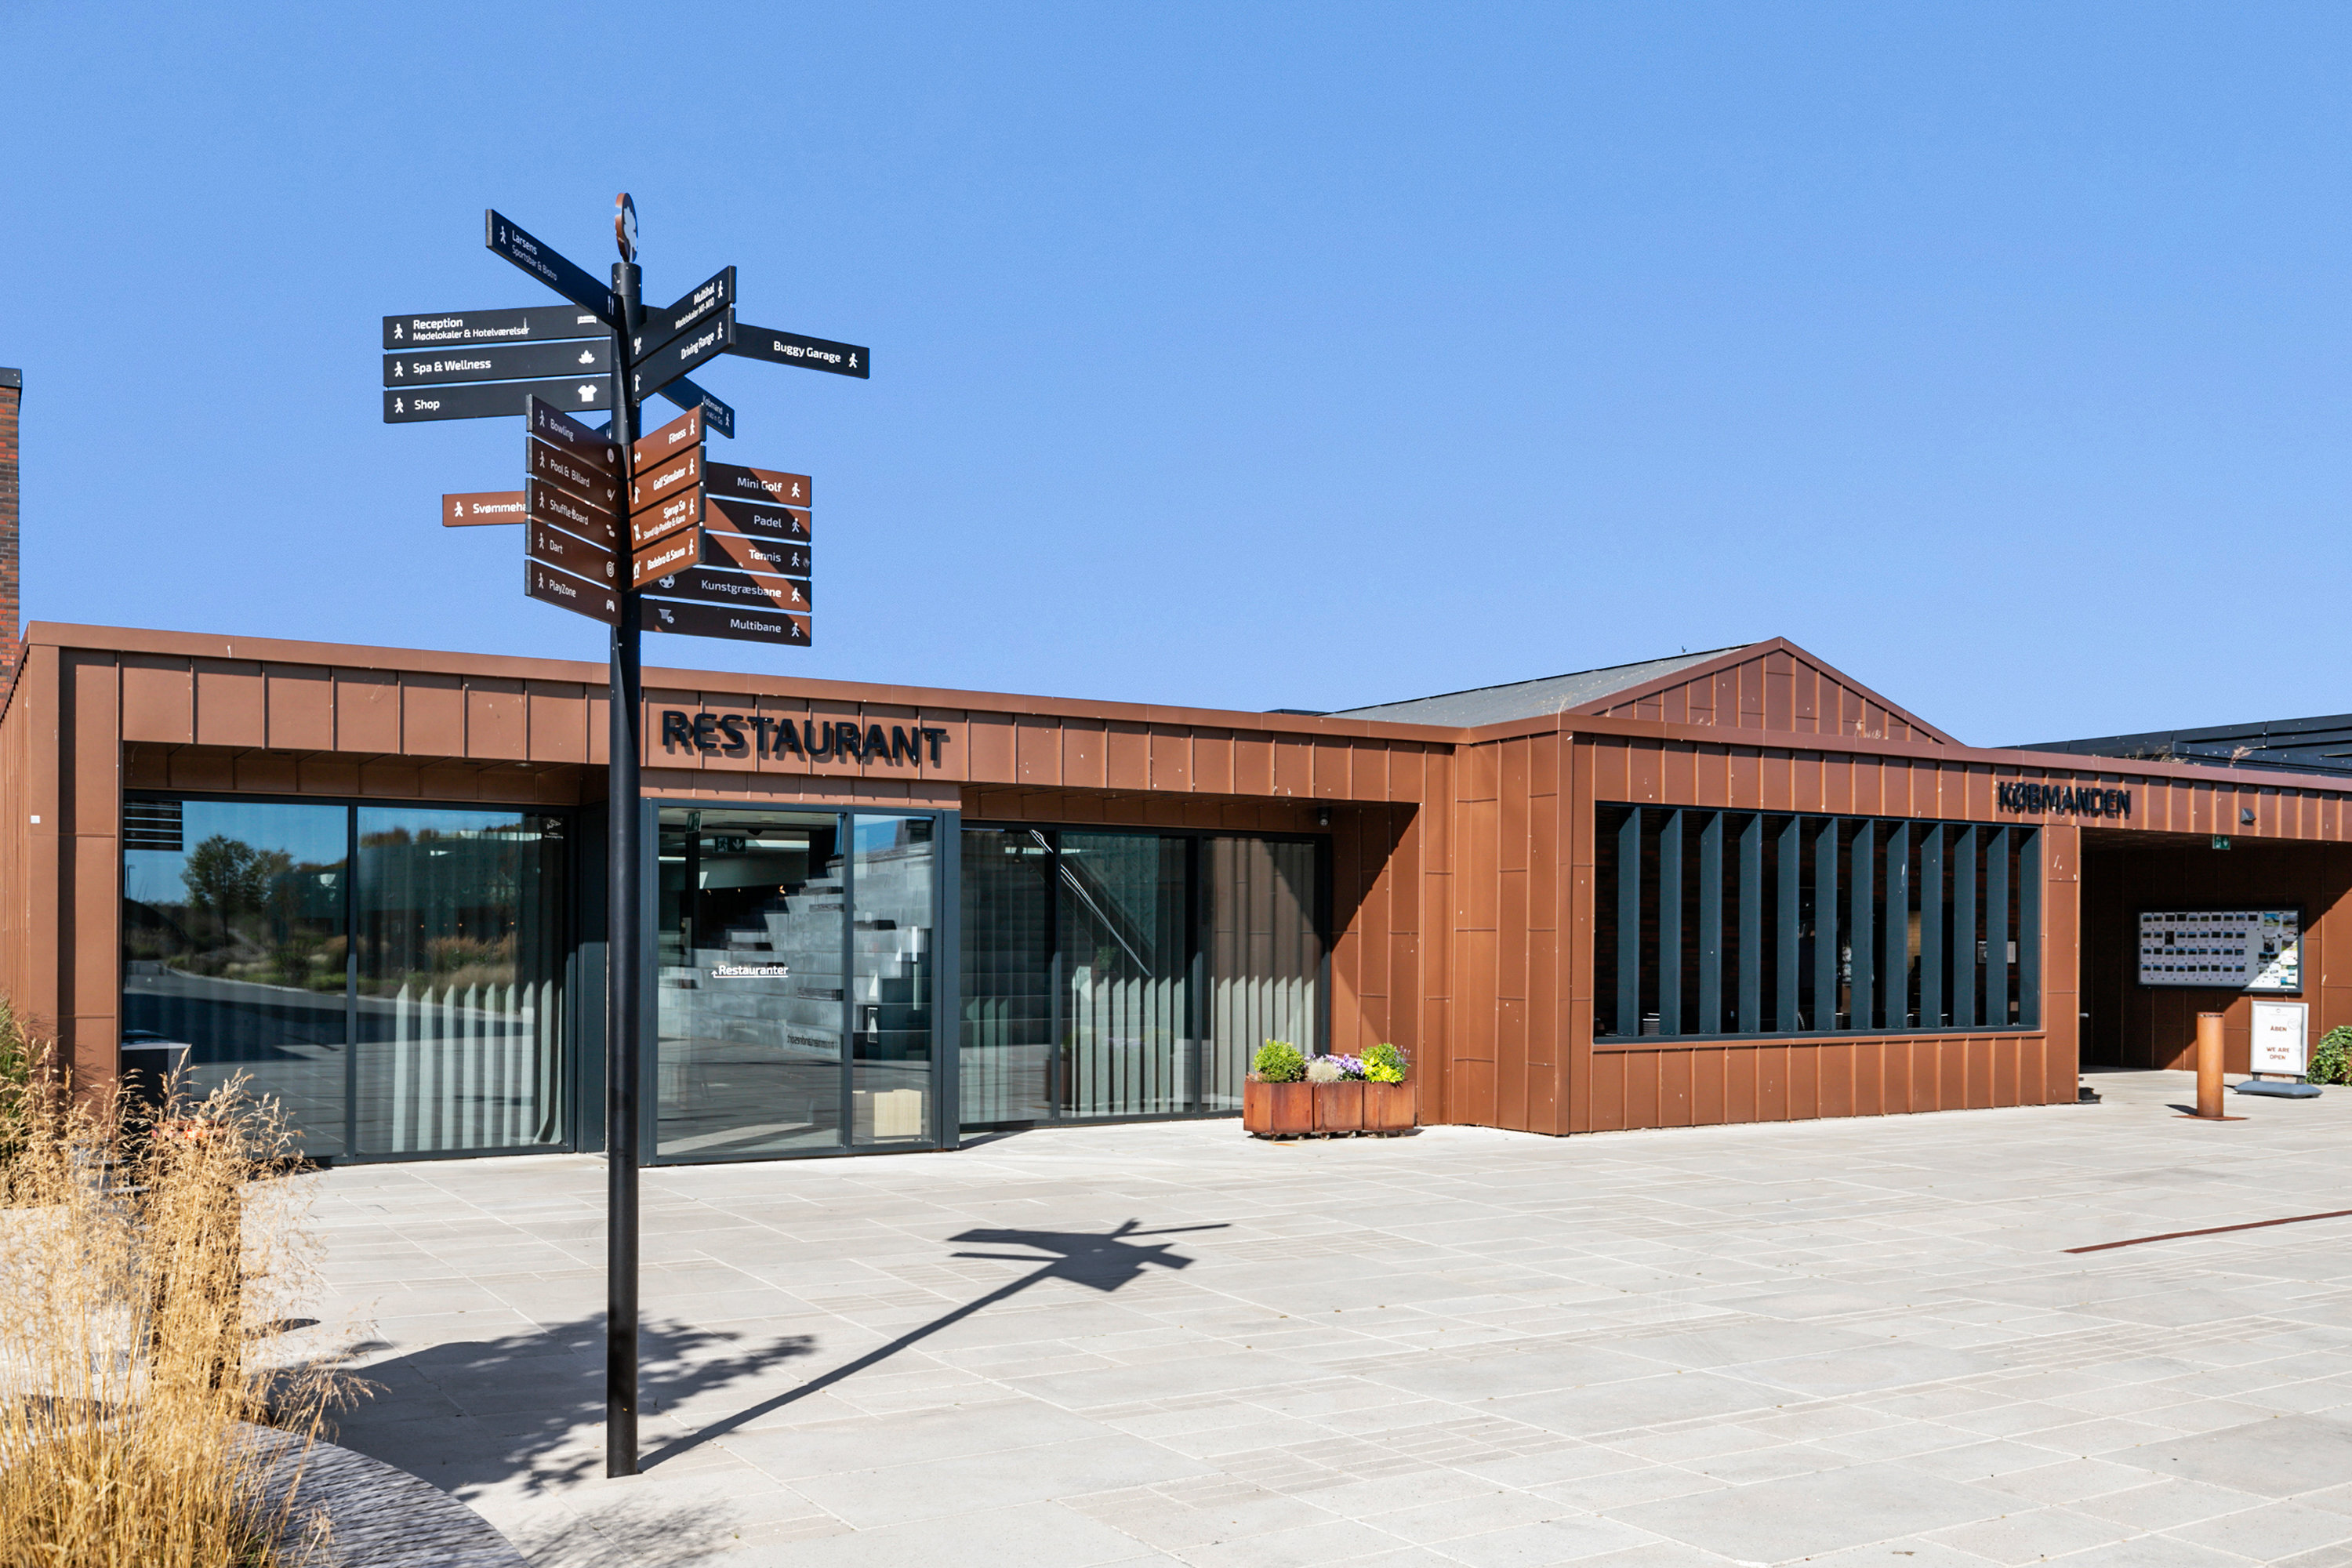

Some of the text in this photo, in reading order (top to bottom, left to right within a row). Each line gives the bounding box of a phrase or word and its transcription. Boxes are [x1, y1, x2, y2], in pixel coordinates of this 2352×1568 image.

[512, 230, 537, 255] Larsens
[537, 261, 543, 271] &
[413, 319, 463, 330] Reception
[413, 332, 463, 341] Mødelokaler
[472, 326, 530, 338] Hotelværelser
[681, 332, 714, 360] Driving Range
[773, 341, 841, 364] Buggy Garage
[413, 360, 492, 375] Spa & Wellness
[415, 400, 440, 411] Shop
[550, 419, 574, 442] Bowling
[669, 428, 686, 445] Fitness
[550, 459, 590, 487] Pool & Billard
[653, 467, 686, 491] Golf Simulator
[737, 477, 782, 492] Mini Golf
[753, 515, 782, 528] Padel
[550, 539, 563, 554] Dart
[670, 547, 686, 561] Sauna
[749, 549, 782, 562] Tennis
[549, 579, 576, 598] PlayZone
[702, 580, 782, 597] Kunstgræsbane
[730, 619, 782, 633] Multibane
[662, 710, 947, 761] RESTAURANT
[1998, 781, 2132, 817] KØBMANDEN
[719, 965, 789, 975] Restauranter
